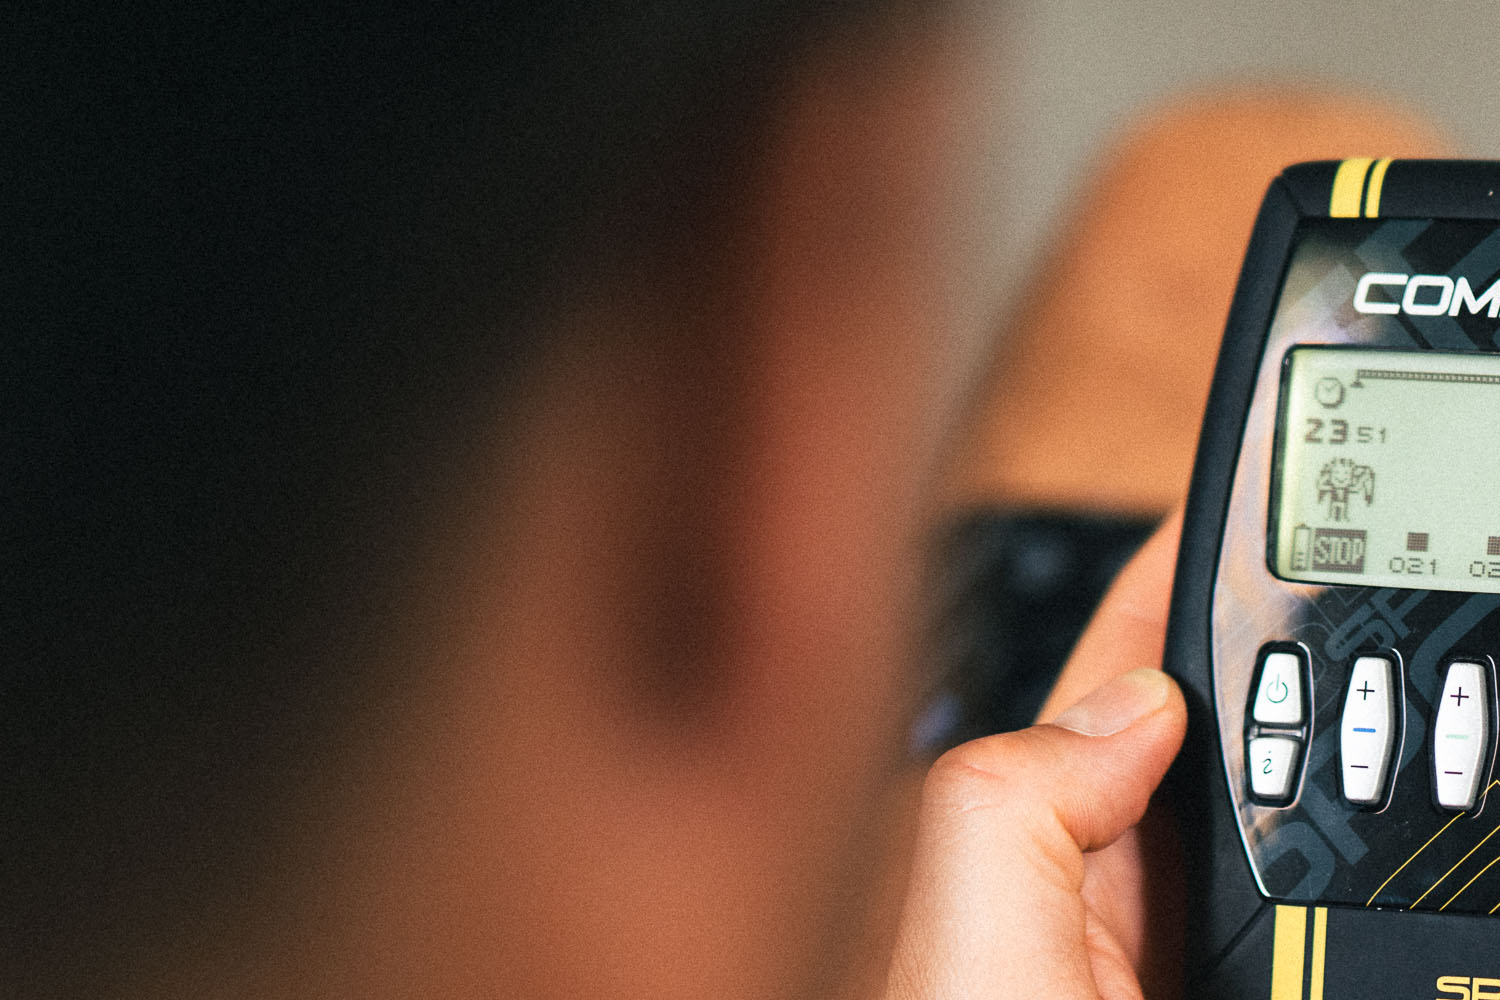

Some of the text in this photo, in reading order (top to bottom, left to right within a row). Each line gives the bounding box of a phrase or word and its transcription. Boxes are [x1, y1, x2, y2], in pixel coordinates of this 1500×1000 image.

[1305, 418, 1349, 444] 23
[1315, 534, 1364, 566] STOP
[1389, 556, 1436, 575] 021
